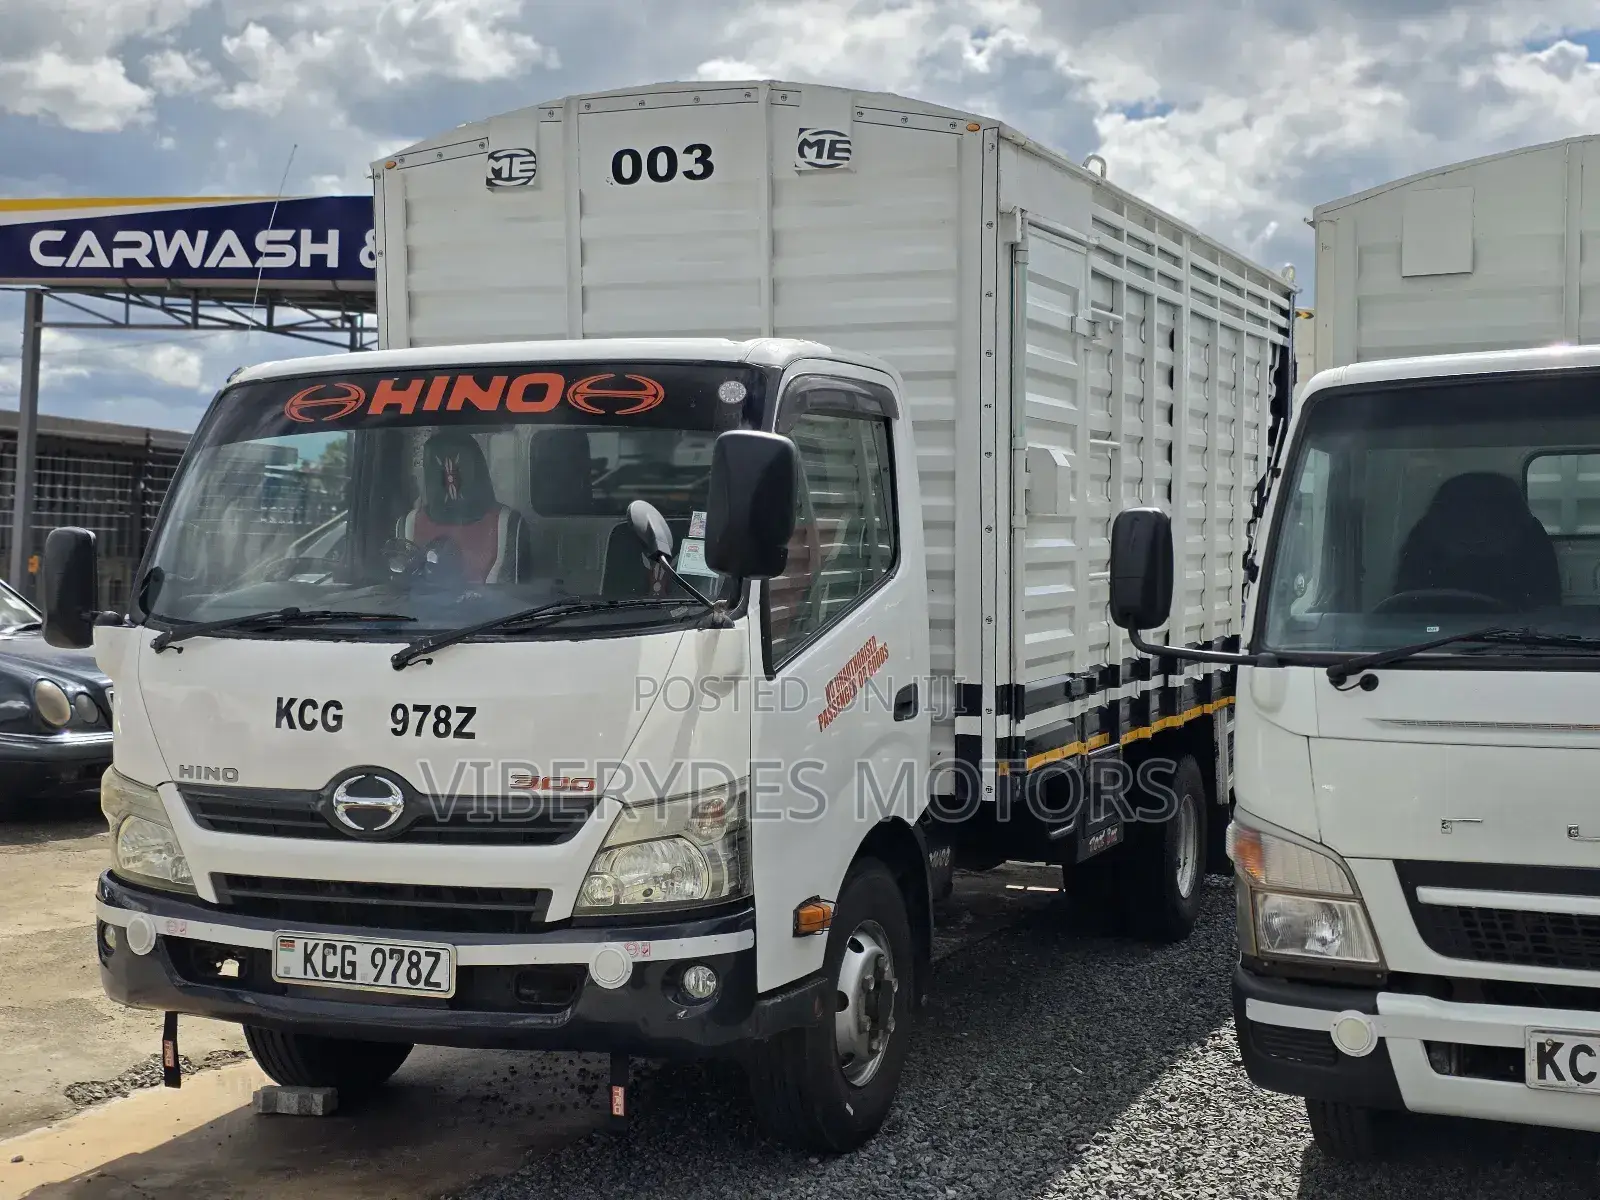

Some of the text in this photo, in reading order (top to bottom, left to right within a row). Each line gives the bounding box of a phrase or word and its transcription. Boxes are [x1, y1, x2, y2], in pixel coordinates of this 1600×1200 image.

[485, 154, 537, 181] ME
[611, 143, 715, 186] 003
[798, 136, 852, 161] ME
[29, 229, 340, 269] CARWASH
[367, 372, 566, 415] HINO
[867, 641, 889, 677] GOODS
[275, 697, 477, 740] KCG 978Z
[179, 764, 239, 783] HINO
[510, 774, 597, 792] 300
[303, 941, 442, 989] KCG 978Z
[1536, 1041, 1598, 1085] KC
